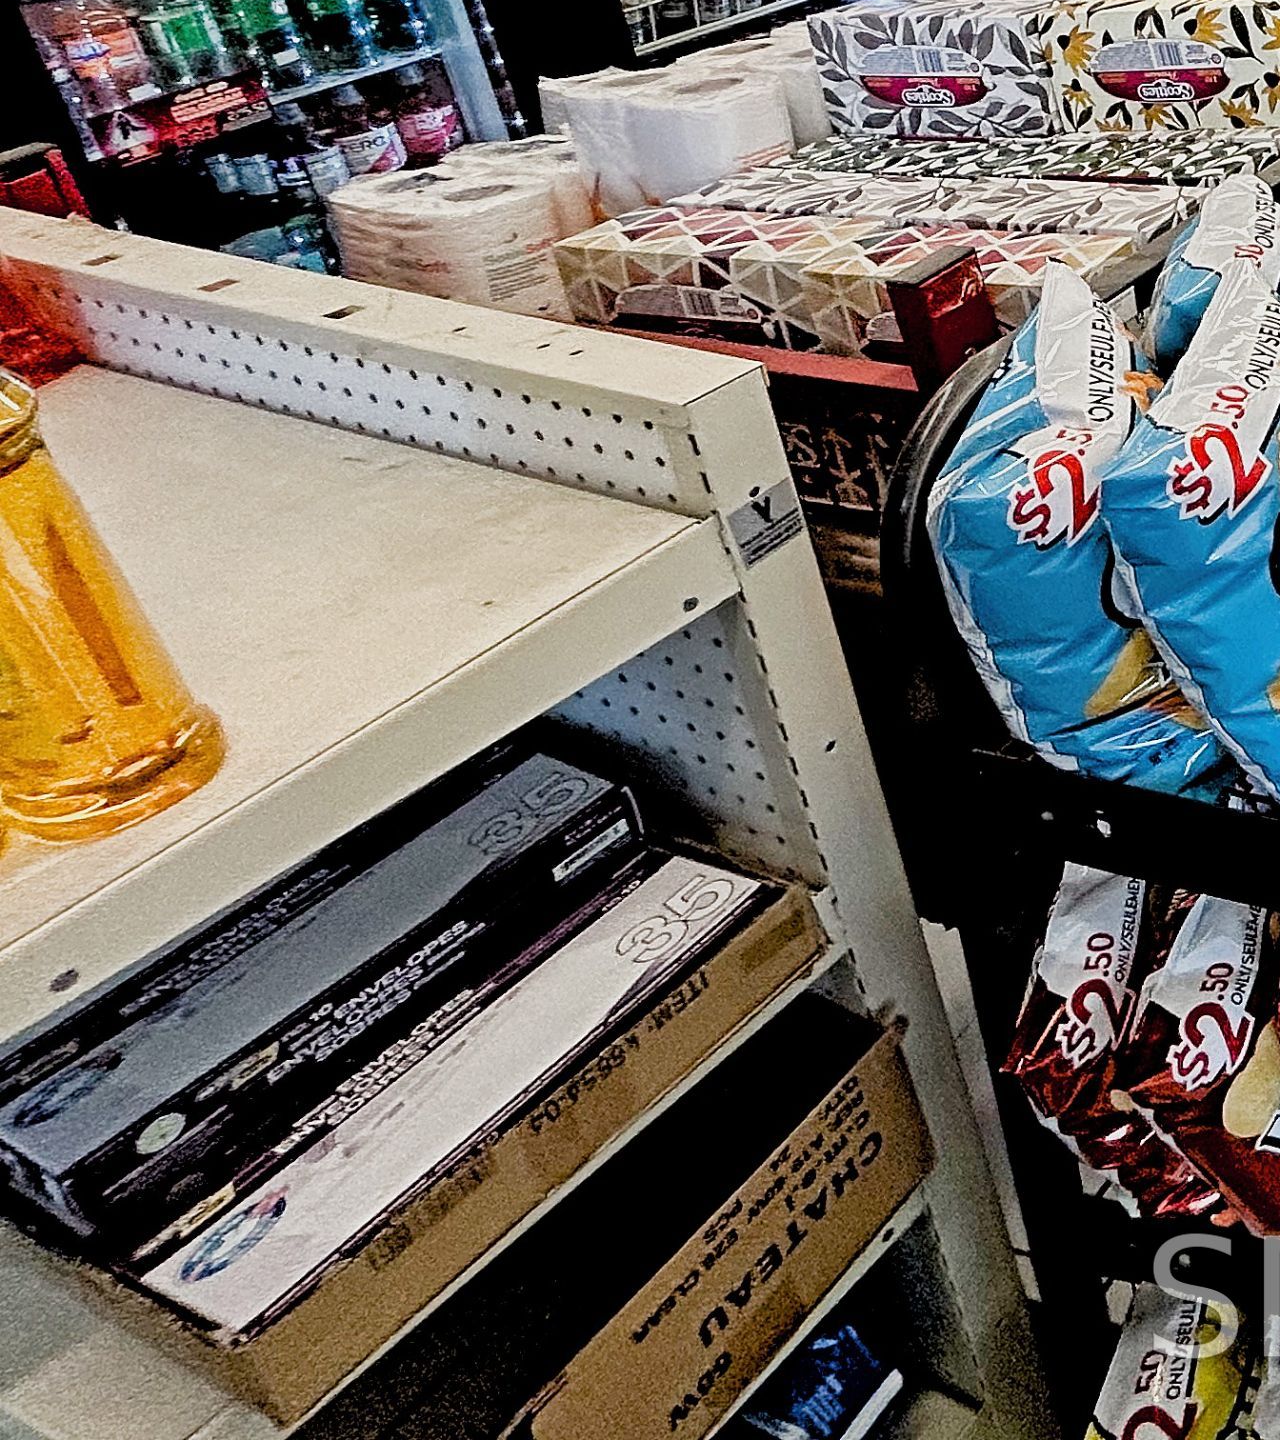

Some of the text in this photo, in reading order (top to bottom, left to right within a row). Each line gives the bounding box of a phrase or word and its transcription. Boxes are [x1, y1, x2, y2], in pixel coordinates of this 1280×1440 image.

[904, 87, 952, 105] Scotties
[1141, 83, 1191, 100] Scotties
[333, 919, 469, 1020] ENVELOPES
[614, 875, 735, 964] 35
[266, 965, 424, 1086] ENVELOPPES
[335, 988, 474, 1094] ENVELOPES
[1058, 931, 1133, 1065] $2.50
[1167, 960, 1251, 1089] $2.50
[700, 1131, 883, 1348] CHATEAU
